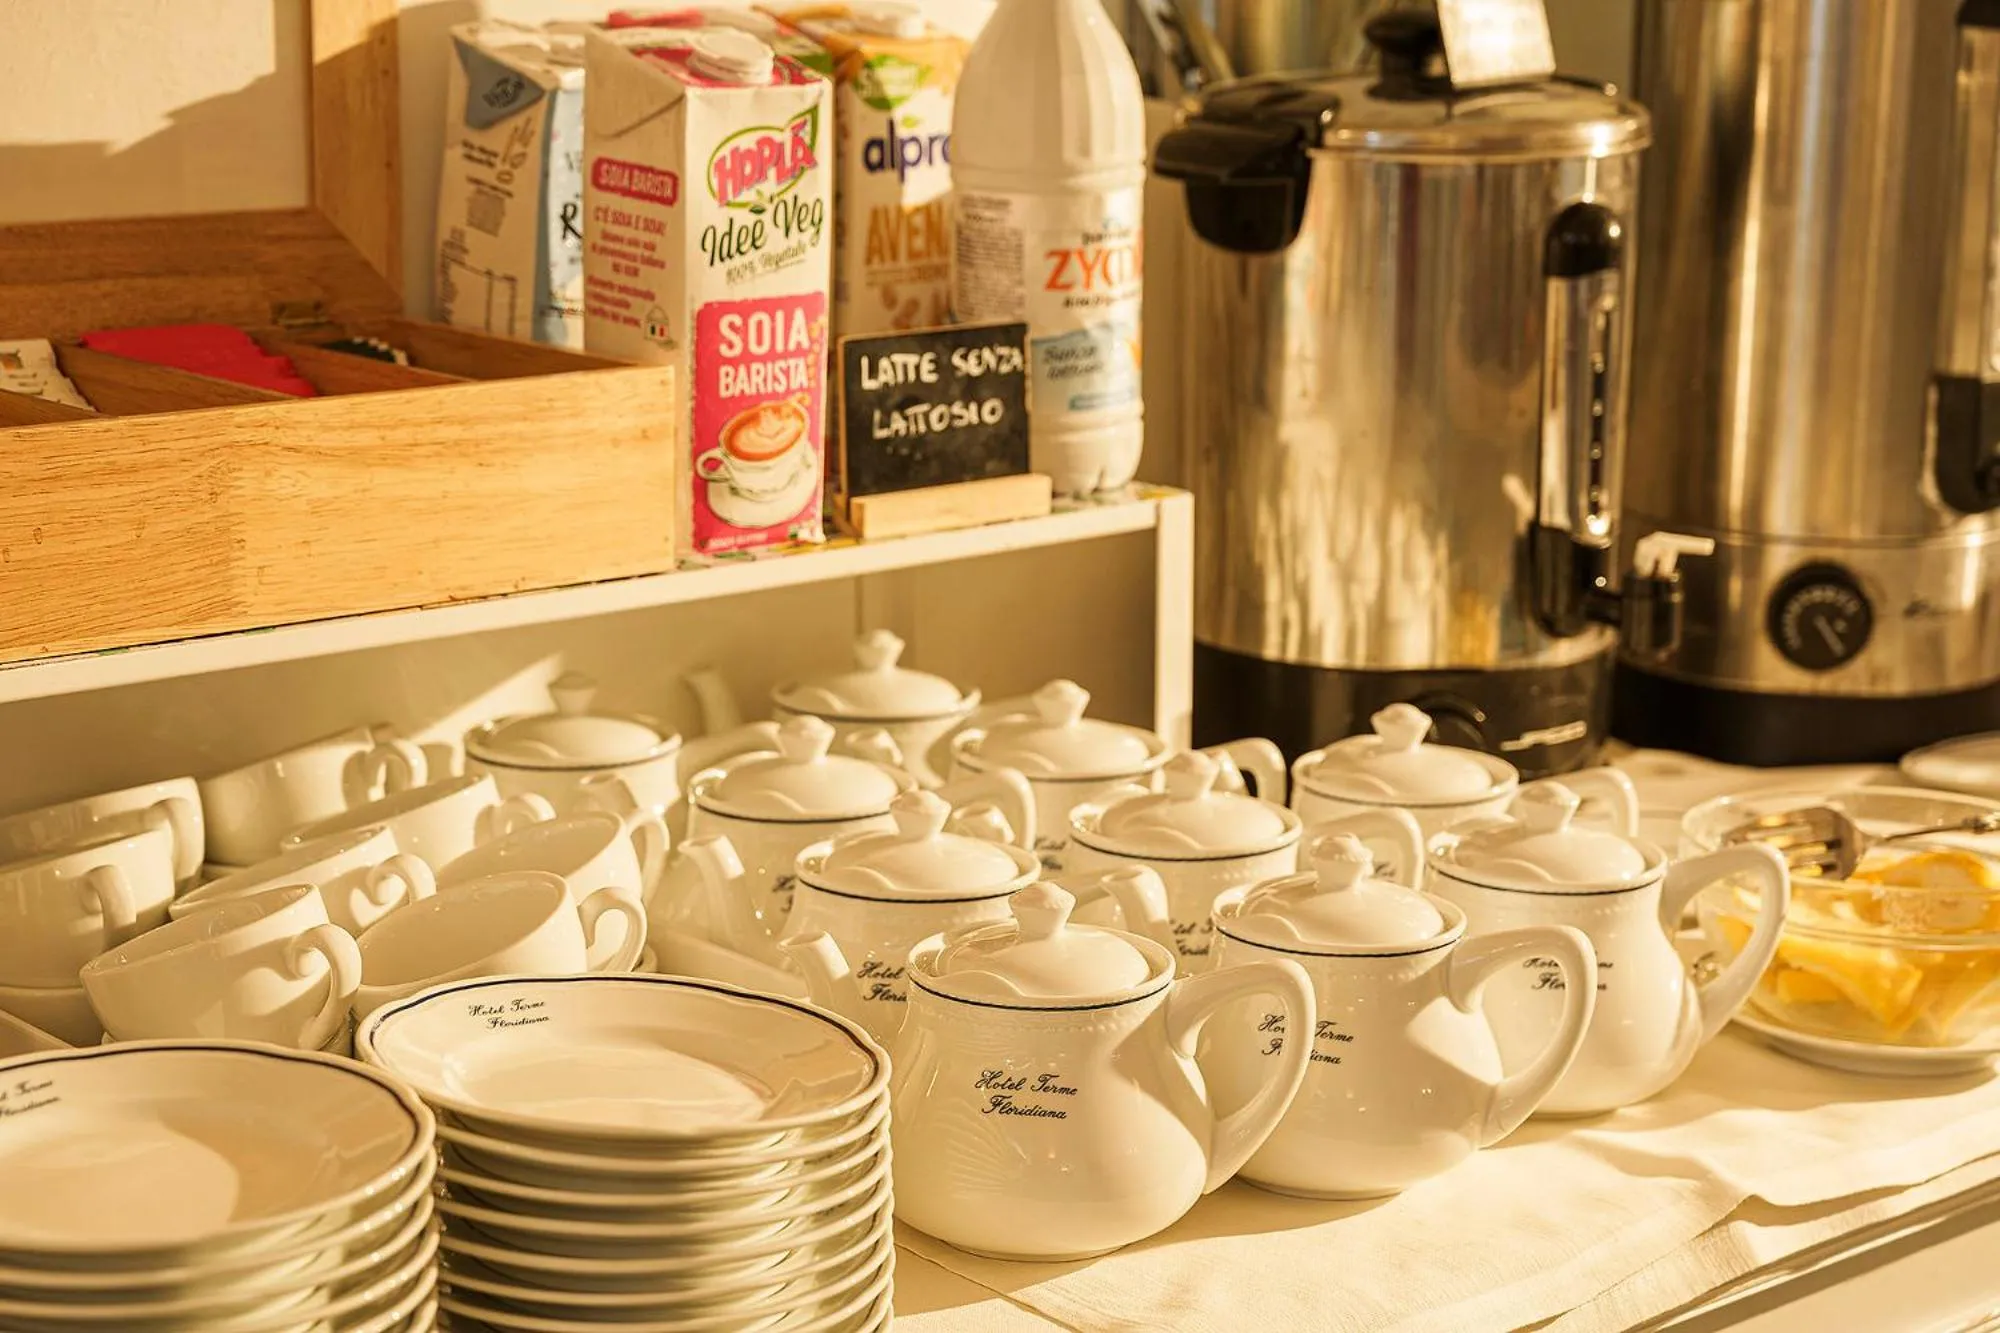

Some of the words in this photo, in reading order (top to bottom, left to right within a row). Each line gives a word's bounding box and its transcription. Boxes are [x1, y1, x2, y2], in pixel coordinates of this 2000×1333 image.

[701, 216, 767, 267] Idee
[770, 193, 824, 247] Veg
[718, 306, 811, 358] SOIA
[718, 356, 809, 398] BARISTA
[860, 351, 939, 391] LATTE
[952, 345, 1024, 378] SENZA
[872, 397, 1004, 440] LATTOSIO
[856, 960, 905, 979] Hotel
[468, 1004, 505, 1017] Hotel
[974, 1069, 1027, 1091] Hotel
[1030, 1073, 1078, 1096] Terme
[981, 1094, 1068, 1120] Floridiana
